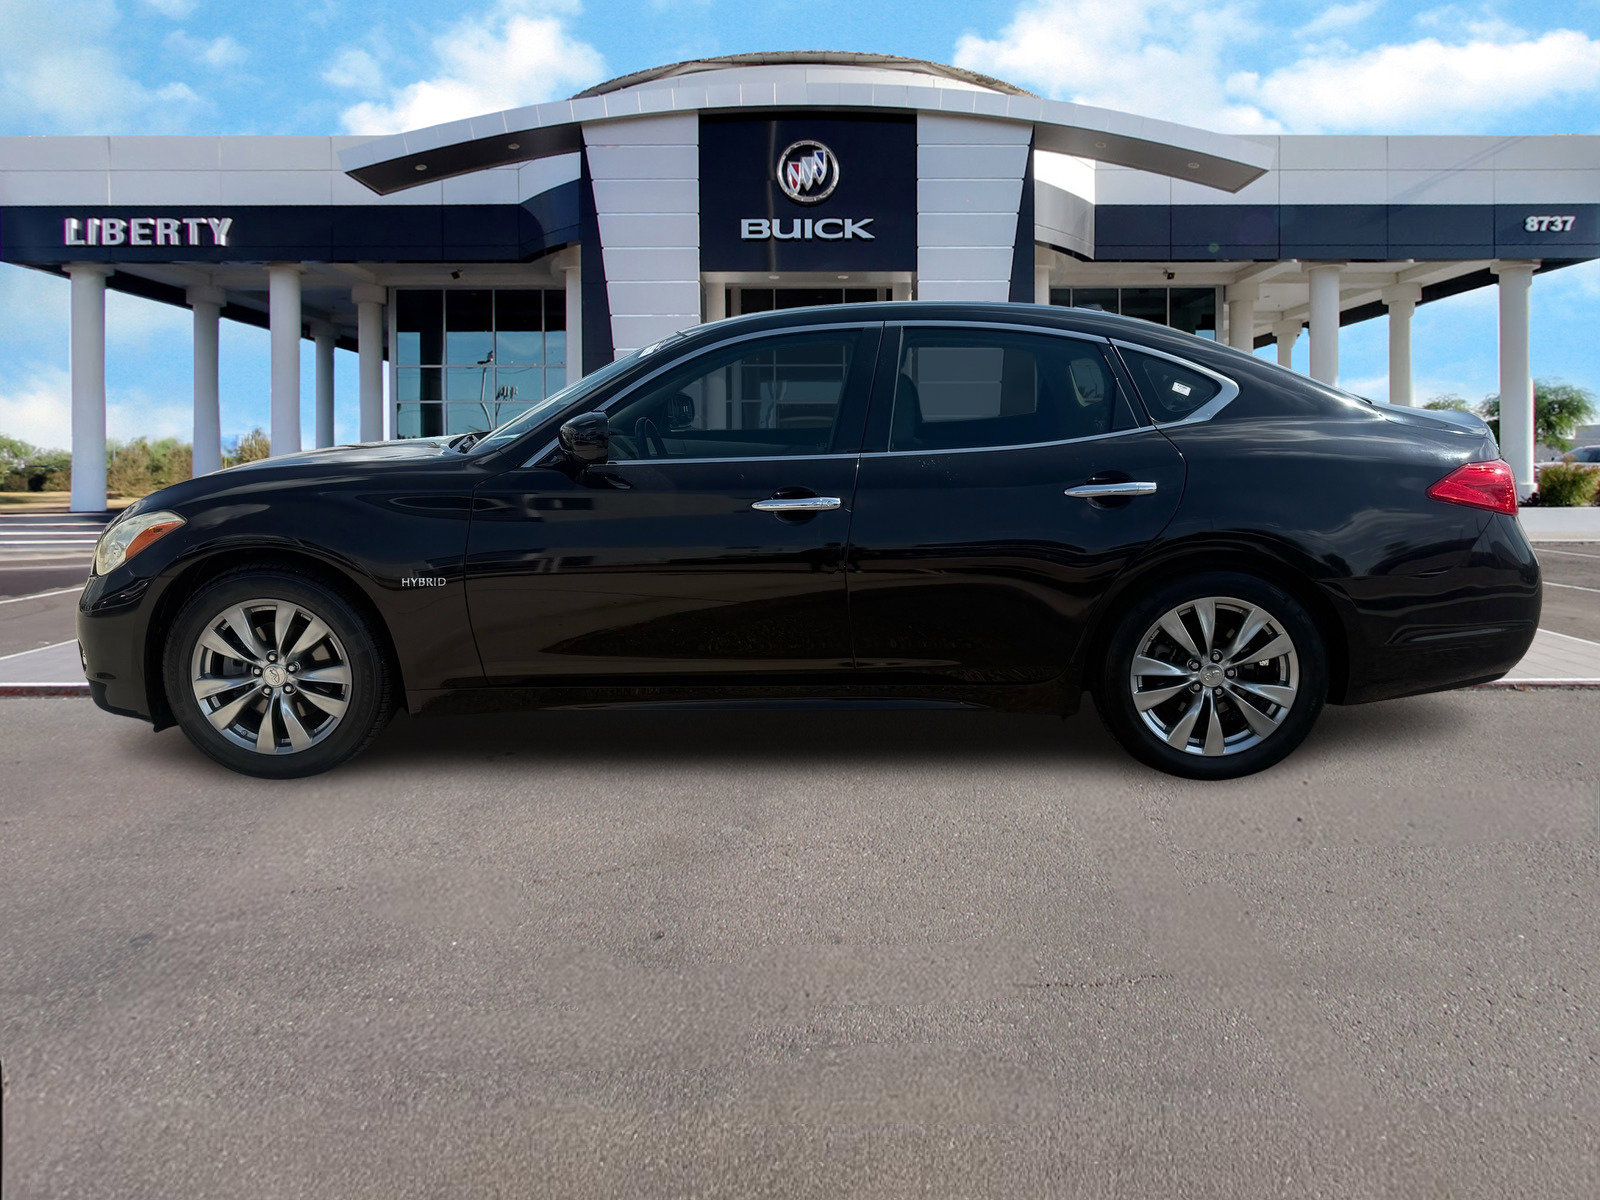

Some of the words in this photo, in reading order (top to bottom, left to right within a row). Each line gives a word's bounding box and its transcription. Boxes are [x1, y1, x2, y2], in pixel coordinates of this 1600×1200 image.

[64, 217, 233, 246] LIBERTY
[740, 218, 875, 239] BUICK
[1524, 215, 1576, 232] 8737
[401, 577, 447, 587] HYBRID
